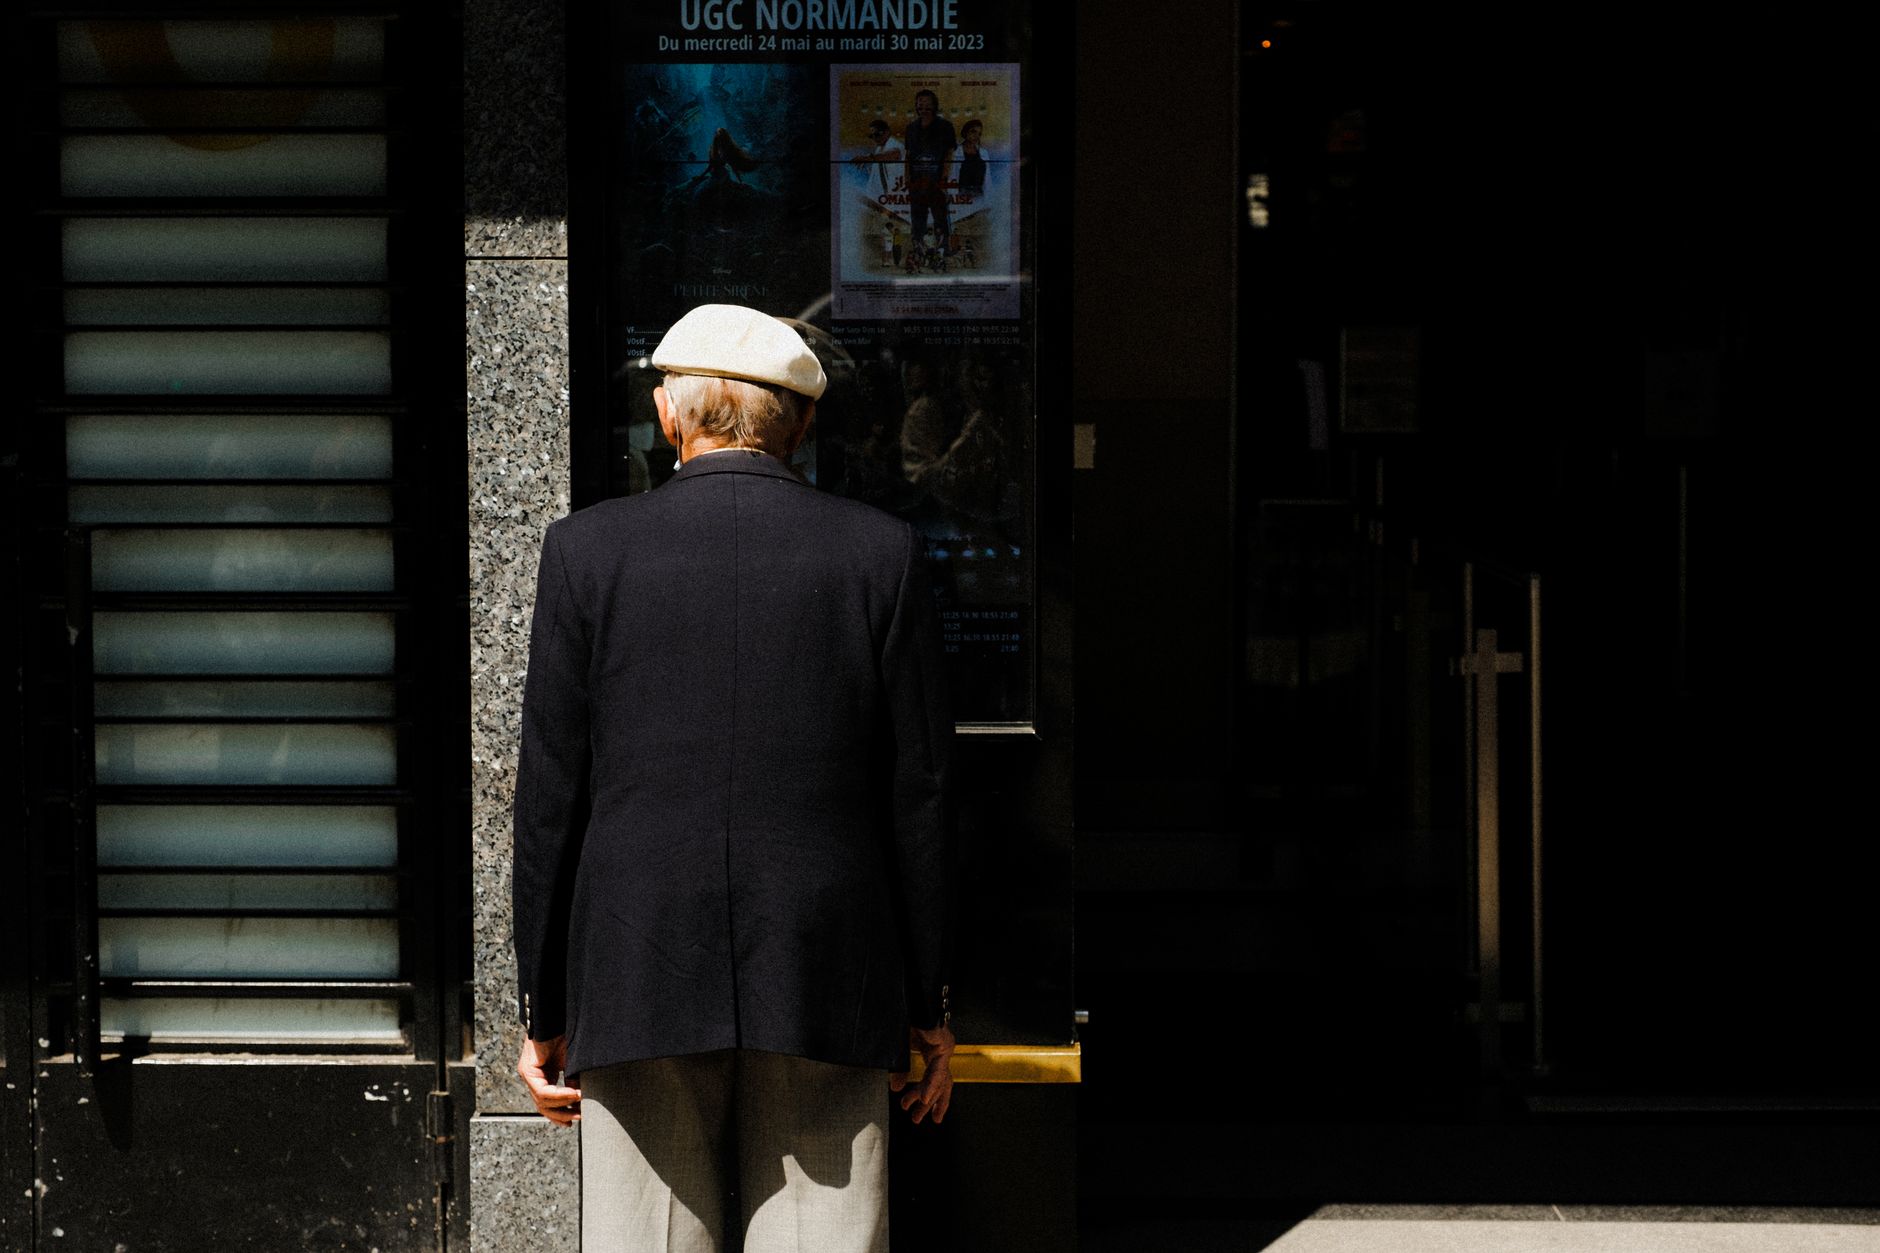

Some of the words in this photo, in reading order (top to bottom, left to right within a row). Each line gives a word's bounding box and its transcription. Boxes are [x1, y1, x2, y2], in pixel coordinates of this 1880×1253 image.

[680, 0, 743, 31] UGC
[755, 0, 959, 30] NORMANDIE
[659, 34, 680, 51] Du
[684, 34, 753, 51] mercredi
[758, 34, 777, 51] 24
[781, 34, 811, 51] mai
[816, 38, 835, 51] au
[839, 34, 886, 51] mardi
[890, 34, 909, 51] 30
[913, 34, 943, 51] mai
[947, 34, 985, 51] 2023
